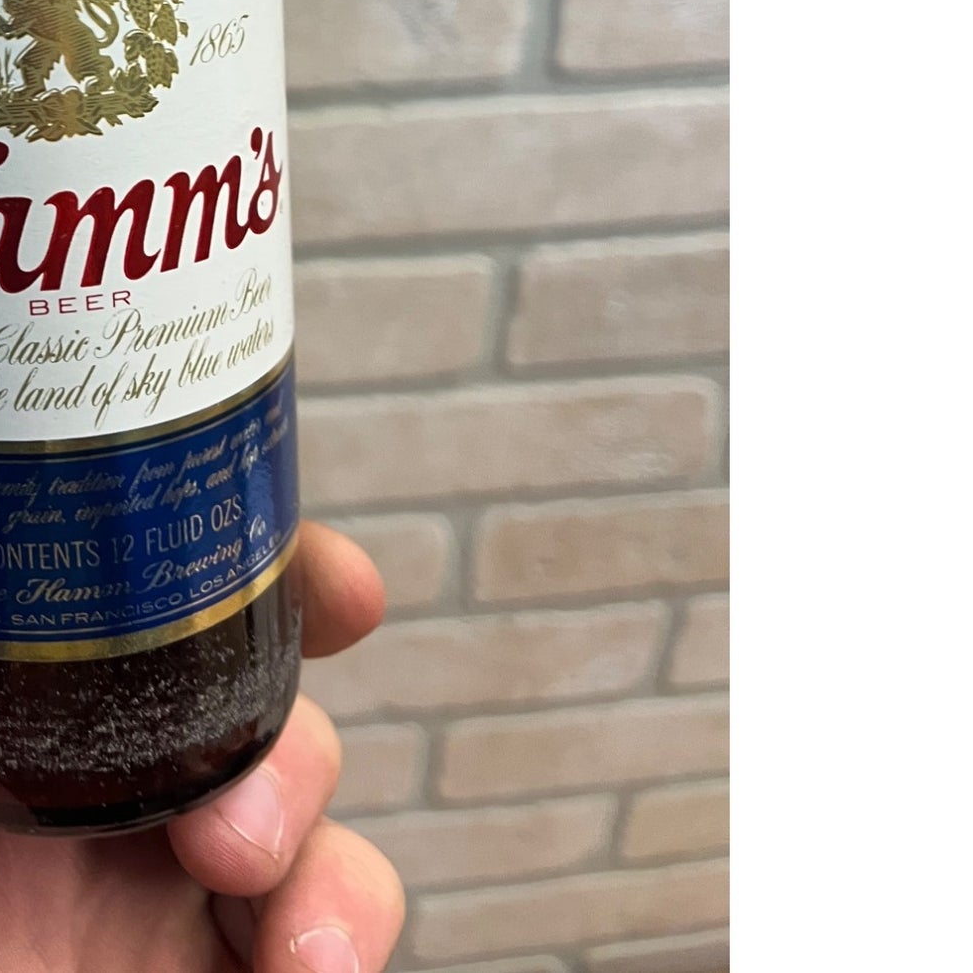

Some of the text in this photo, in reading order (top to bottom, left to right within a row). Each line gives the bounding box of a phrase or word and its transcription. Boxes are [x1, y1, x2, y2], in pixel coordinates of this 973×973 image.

[188, 12, 250, 67] 1865
[29, 290, 132, 316] BEER
[94, 300, 229, 358] Premium
[230, 267, 273, 321] Beer
[12, 366, 87, 414] land
[91, 370, 124, 432] of
[121, 364, 172, 419] sky
[177, 336, 225, 388] blue
[226, 317, 276, 370] waters
[47, 473, 126, 496] tradition
[128, 457, 175, 499] from
[74, 482, 162, 530] imported
[206, 451, 238, 490] and
[111, 534, 135, 565] 12
[145, 514, 204, 556] FLUID
[15, 578, 132, 606] Hamm
[135, 538, 244, 594] Brewing
[11, 613, 56, 627] SAN
[60, 592, 181, 626] FRANCISCO
[189, 577, 225, 599] LOS
